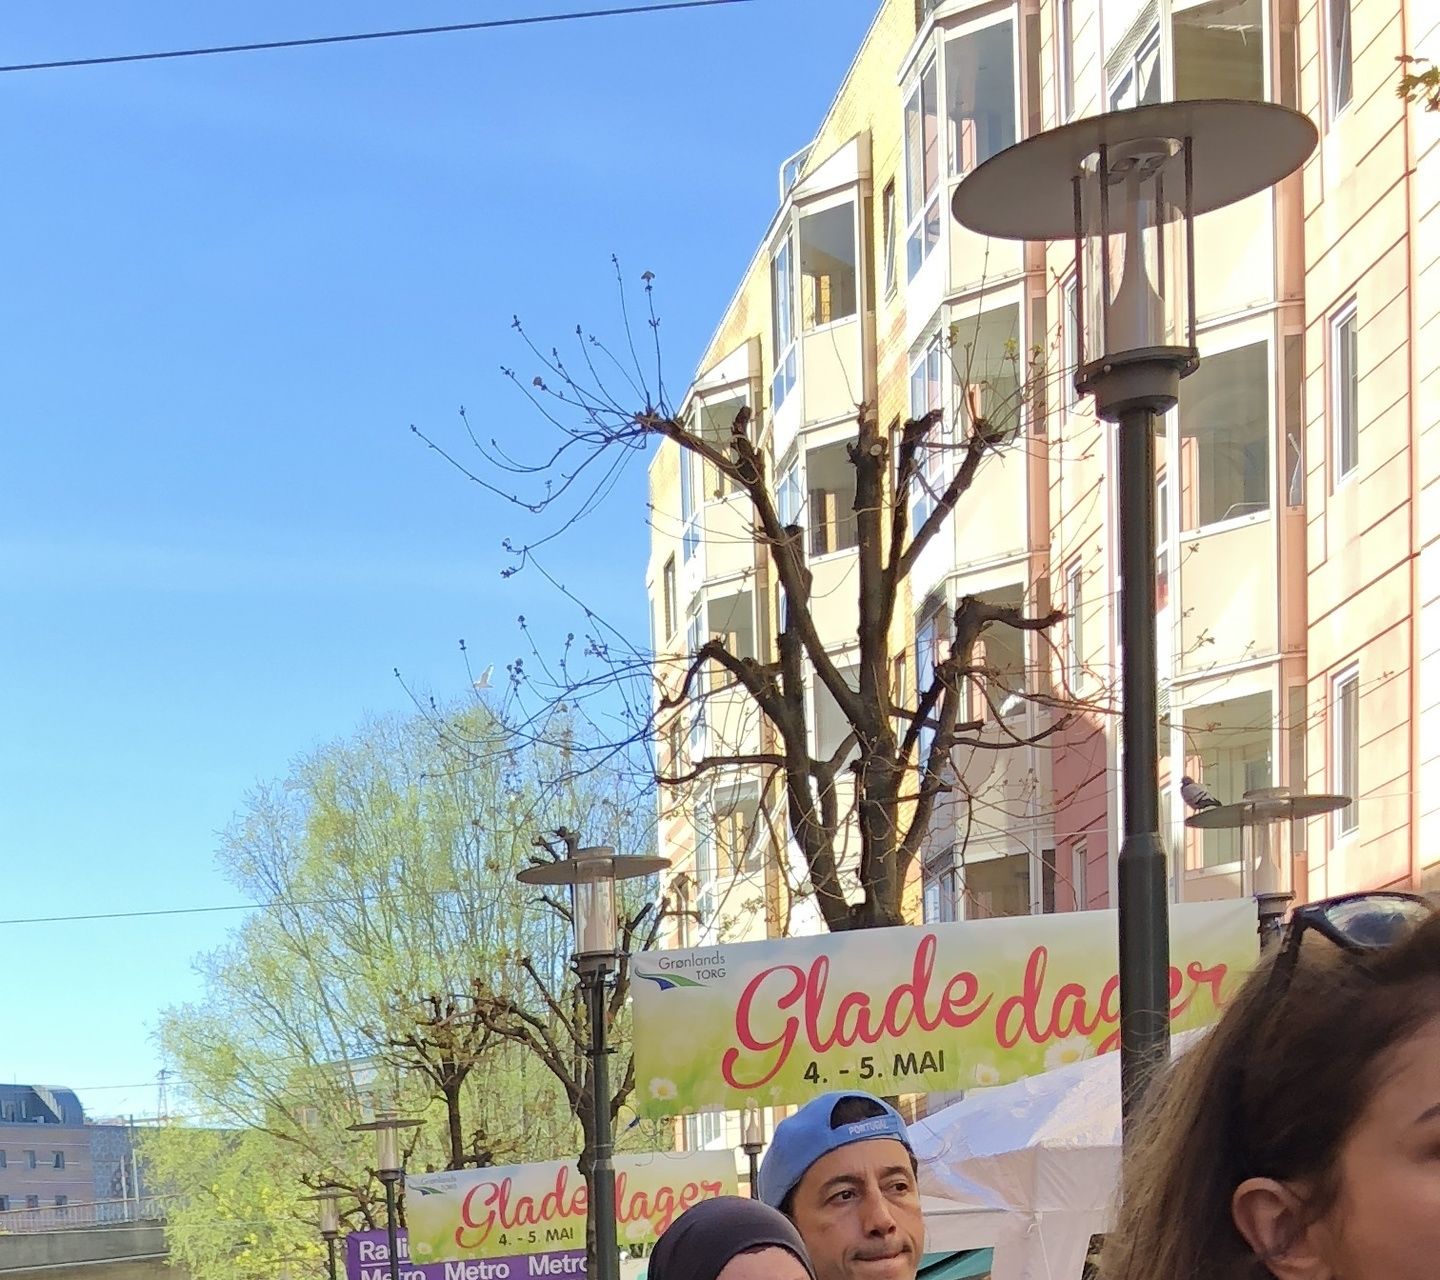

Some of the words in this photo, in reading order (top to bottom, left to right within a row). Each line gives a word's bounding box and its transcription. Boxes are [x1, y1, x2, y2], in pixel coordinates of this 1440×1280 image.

[659, 951, 726, 970] Grønlands
[696, 967, 726, 981] TORG
[722, 934, 994, 1089] Glade
[804, 1062, 828, 1083] 4.
[860, 1056, 883, 1079] 5.
[893, 1050, 945, 1076] MAI
[848, 1120, 889, 1136] PORTUGAL
[546, 1228, 574, 1243] MAI
